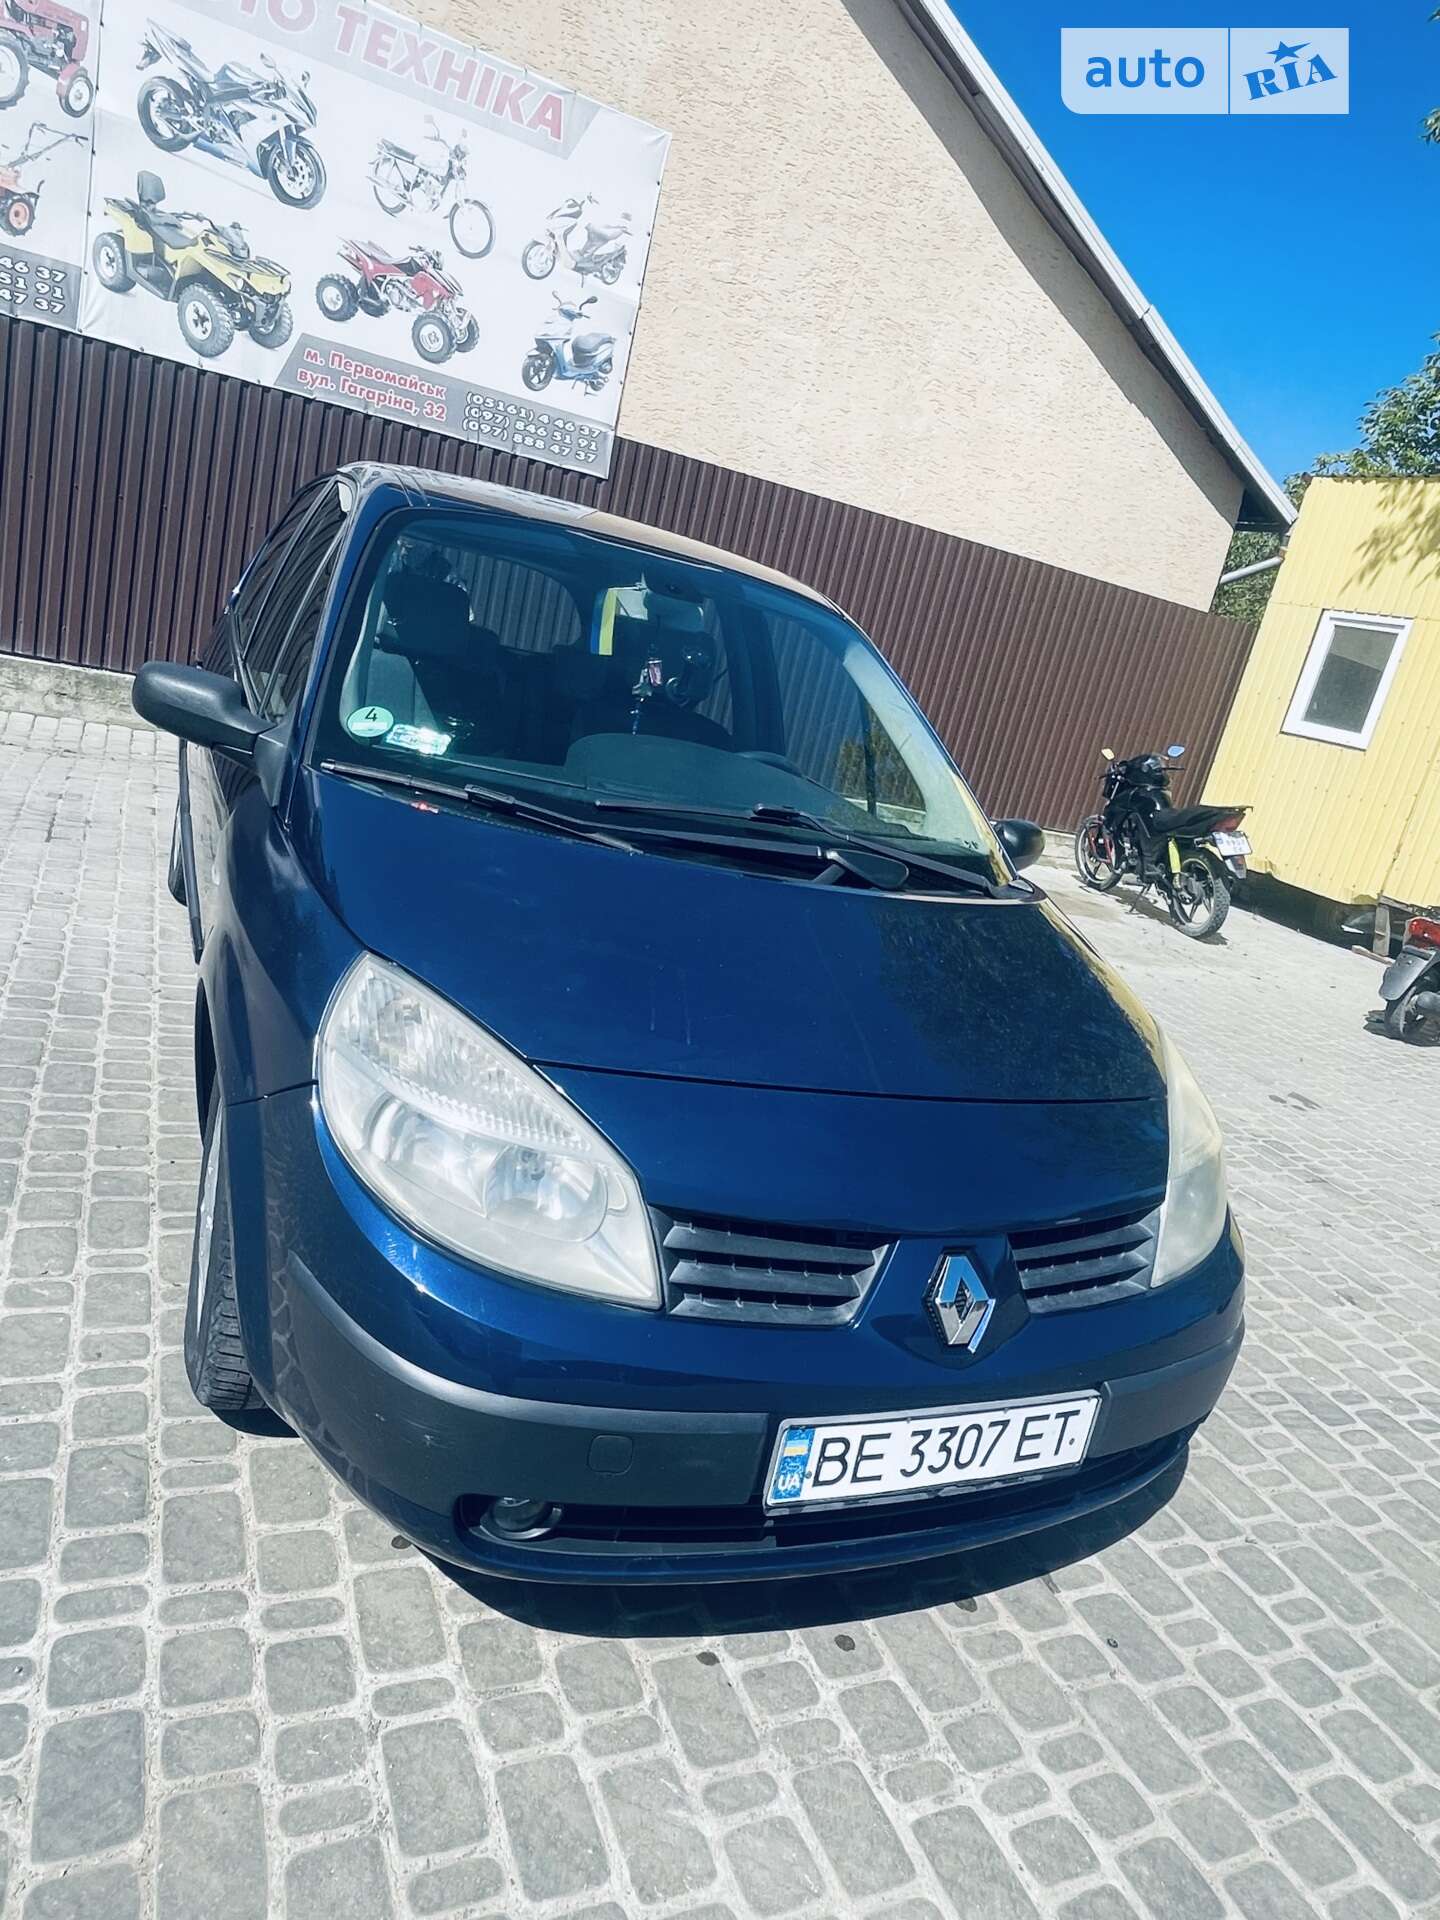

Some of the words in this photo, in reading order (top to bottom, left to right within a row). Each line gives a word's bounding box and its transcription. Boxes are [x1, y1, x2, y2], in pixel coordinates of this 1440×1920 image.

[335, 4, 565, 142] ТЕХНІКА
[0, 256, 30, 274] 46
[35, 265, 67, 283] 37
[34, 281, 64, 300] 91
[0, 288, 28, 305] 47
[33, 297, 65, 314] 37
[297, 368, 336, 390] вул.
[339, 377, 420, 416] Гагаріна,
[423, 401, 447, 421] 32
[304, 348, 325, 365] м.
[329, 351, 447, 400] Первомайськ
[464, 404, 511, 430] (097)
[514, 420, 549, 437] 846
[551, 431, 573, 446] 51
[578, 438, 598, 452] 91
[467, 391, 535, 422] (05161)
[538, 414, 550, 425] 4
[553, 419, 577, 433] 46
[579, 424, 601, 439] 37
[462, 417, 509, 442] (097)
[512, 432, 546, 450] 888
[549, 443, 572, 457] 47
[575, 450, 598, 464] 37
[364, 707, 378, 722] 4
[812, 1432, 892, 1488] BE
[900, 1419, 1011, 1479] 3307
[1014, 1409, 1081, 1464] ET
[778, 1472, 801, 1490] UA
